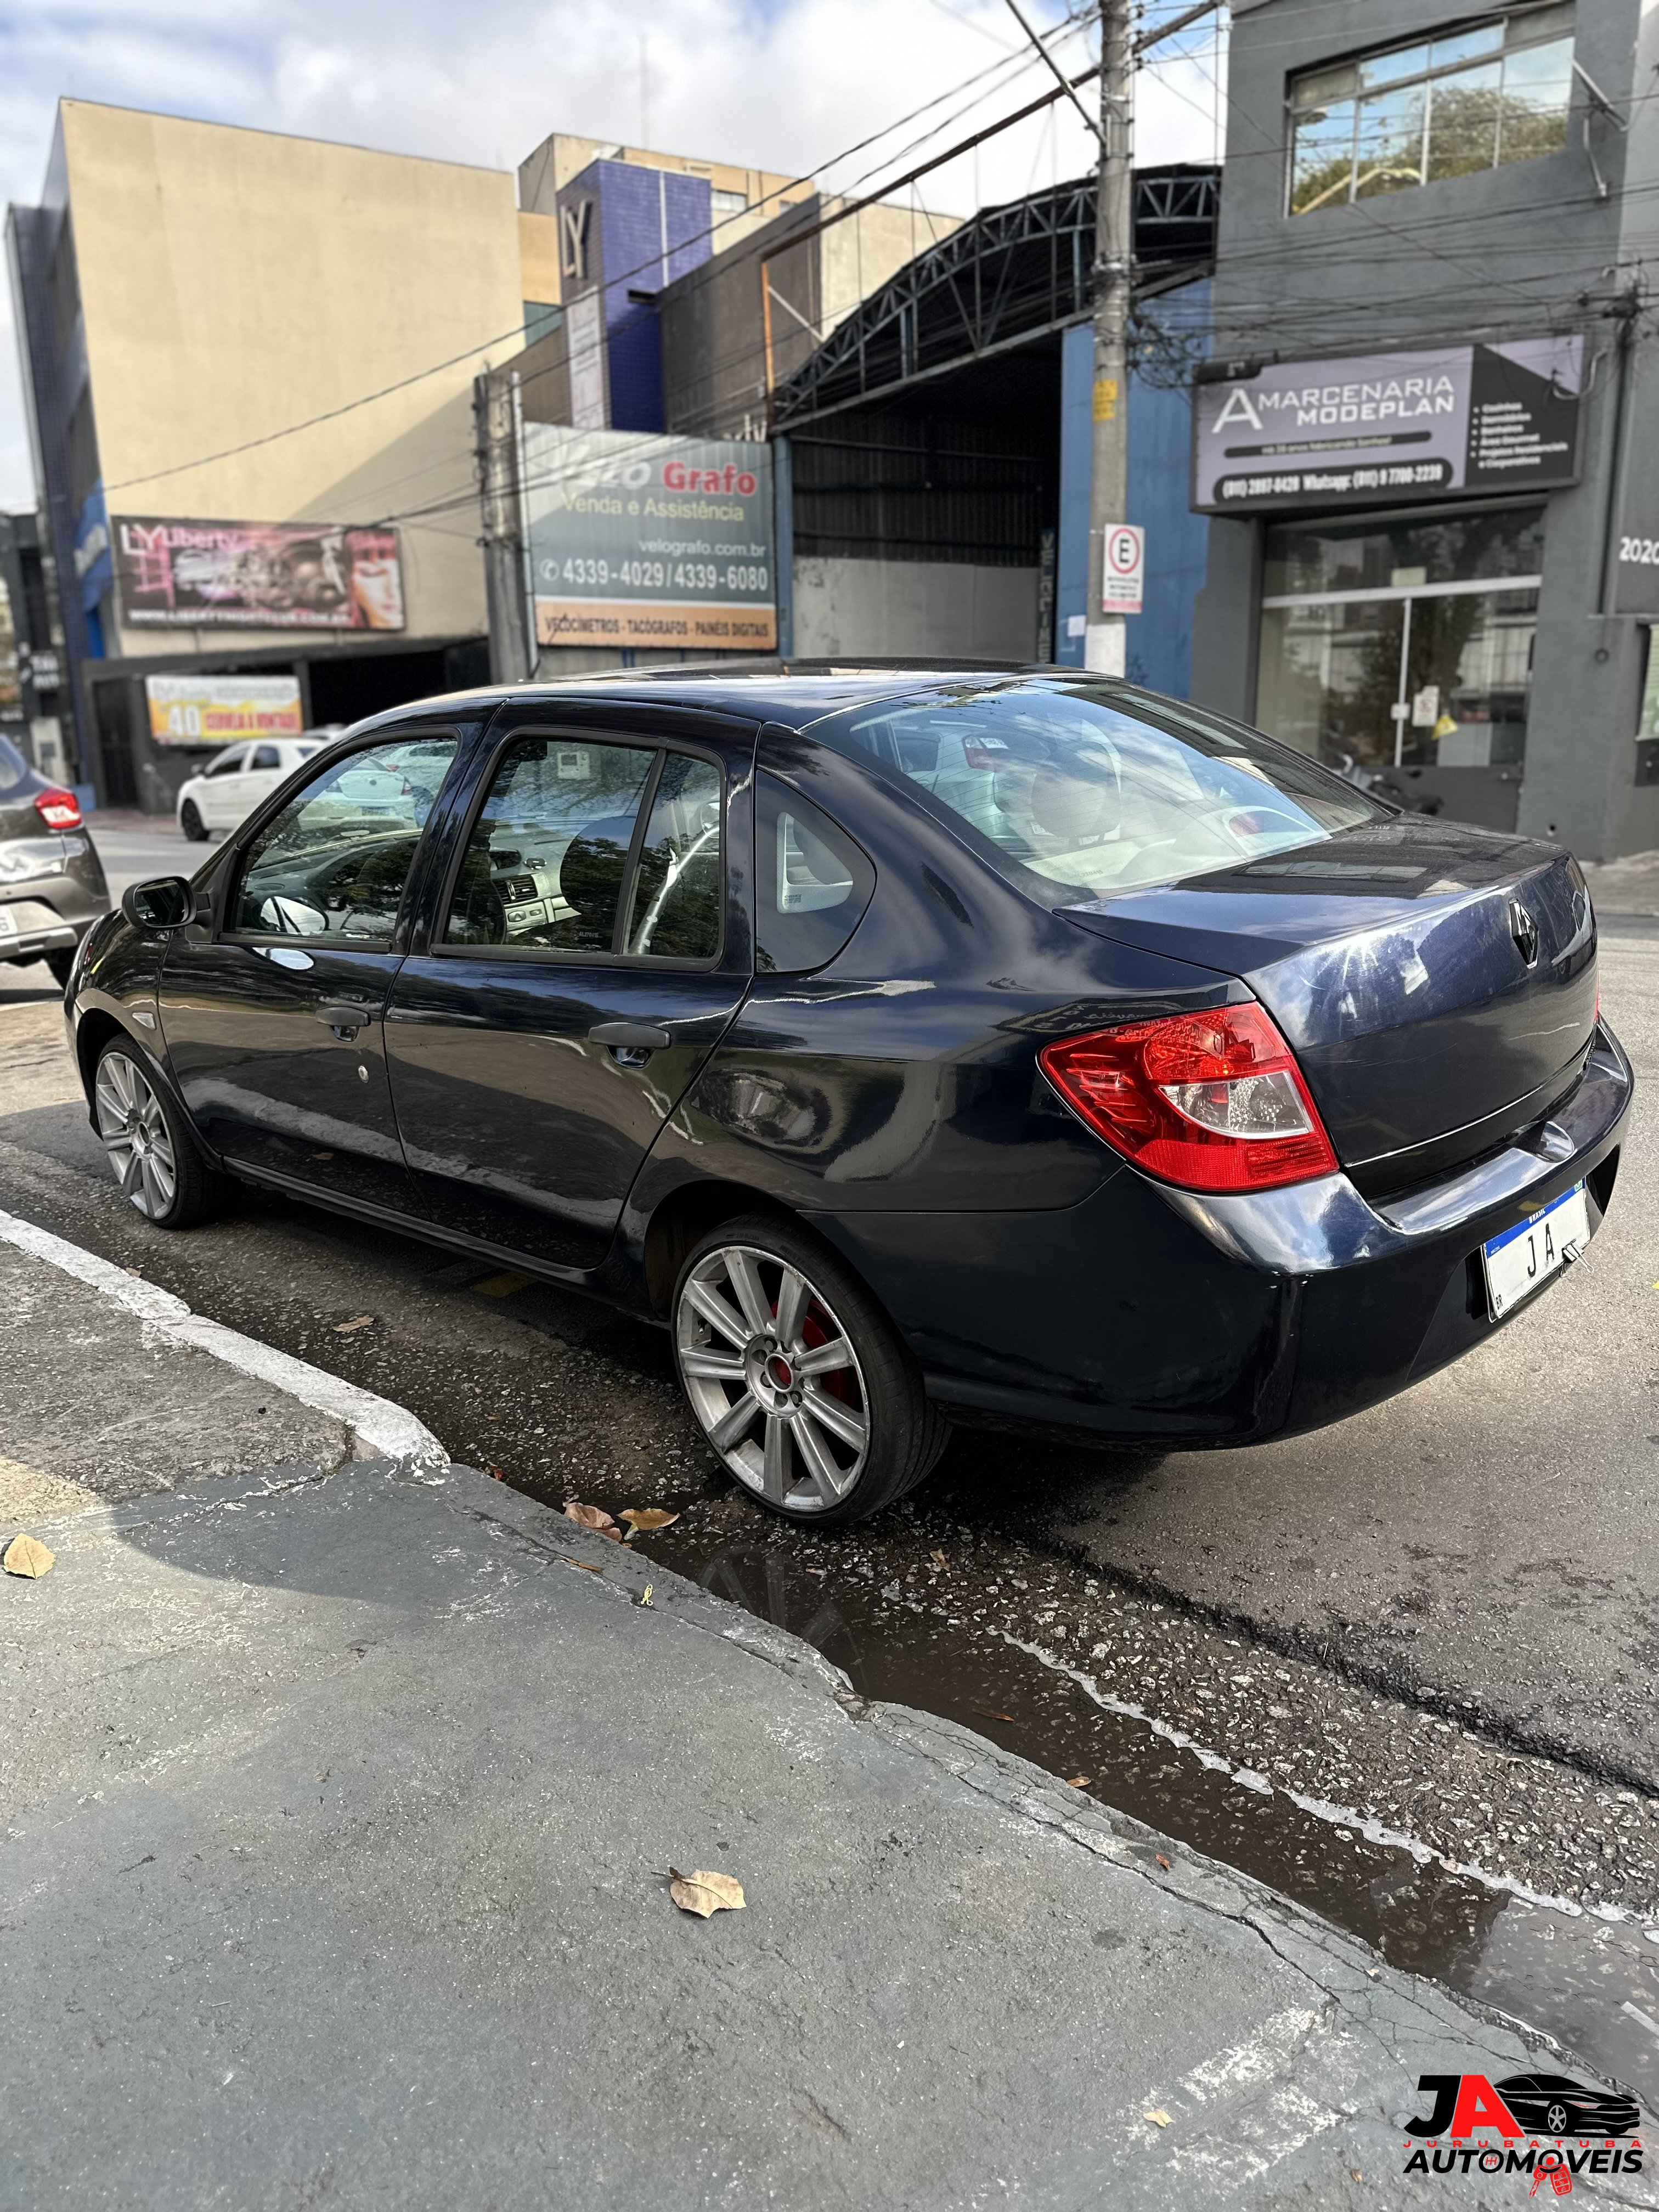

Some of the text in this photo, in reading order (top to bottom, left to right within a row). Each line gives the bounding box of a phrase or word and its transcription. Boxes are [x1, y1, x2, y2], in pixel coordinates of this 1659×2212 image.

[560, 199, 588, 279] LY
[1258, 375, 1454, 411] MARCENARIA
[1296, 395, 1454, 426] MODEPLAN
[662, 461, 757, 496] Grafo
[562, 492, 744, 522] Venda e Assistência
[120, 523, 165, 556] LY
[639, 538, 766, 558] velografo.com.br
[1119, 538, 1130, 563] E
[1496, 1294, 1503, 1310] BR
